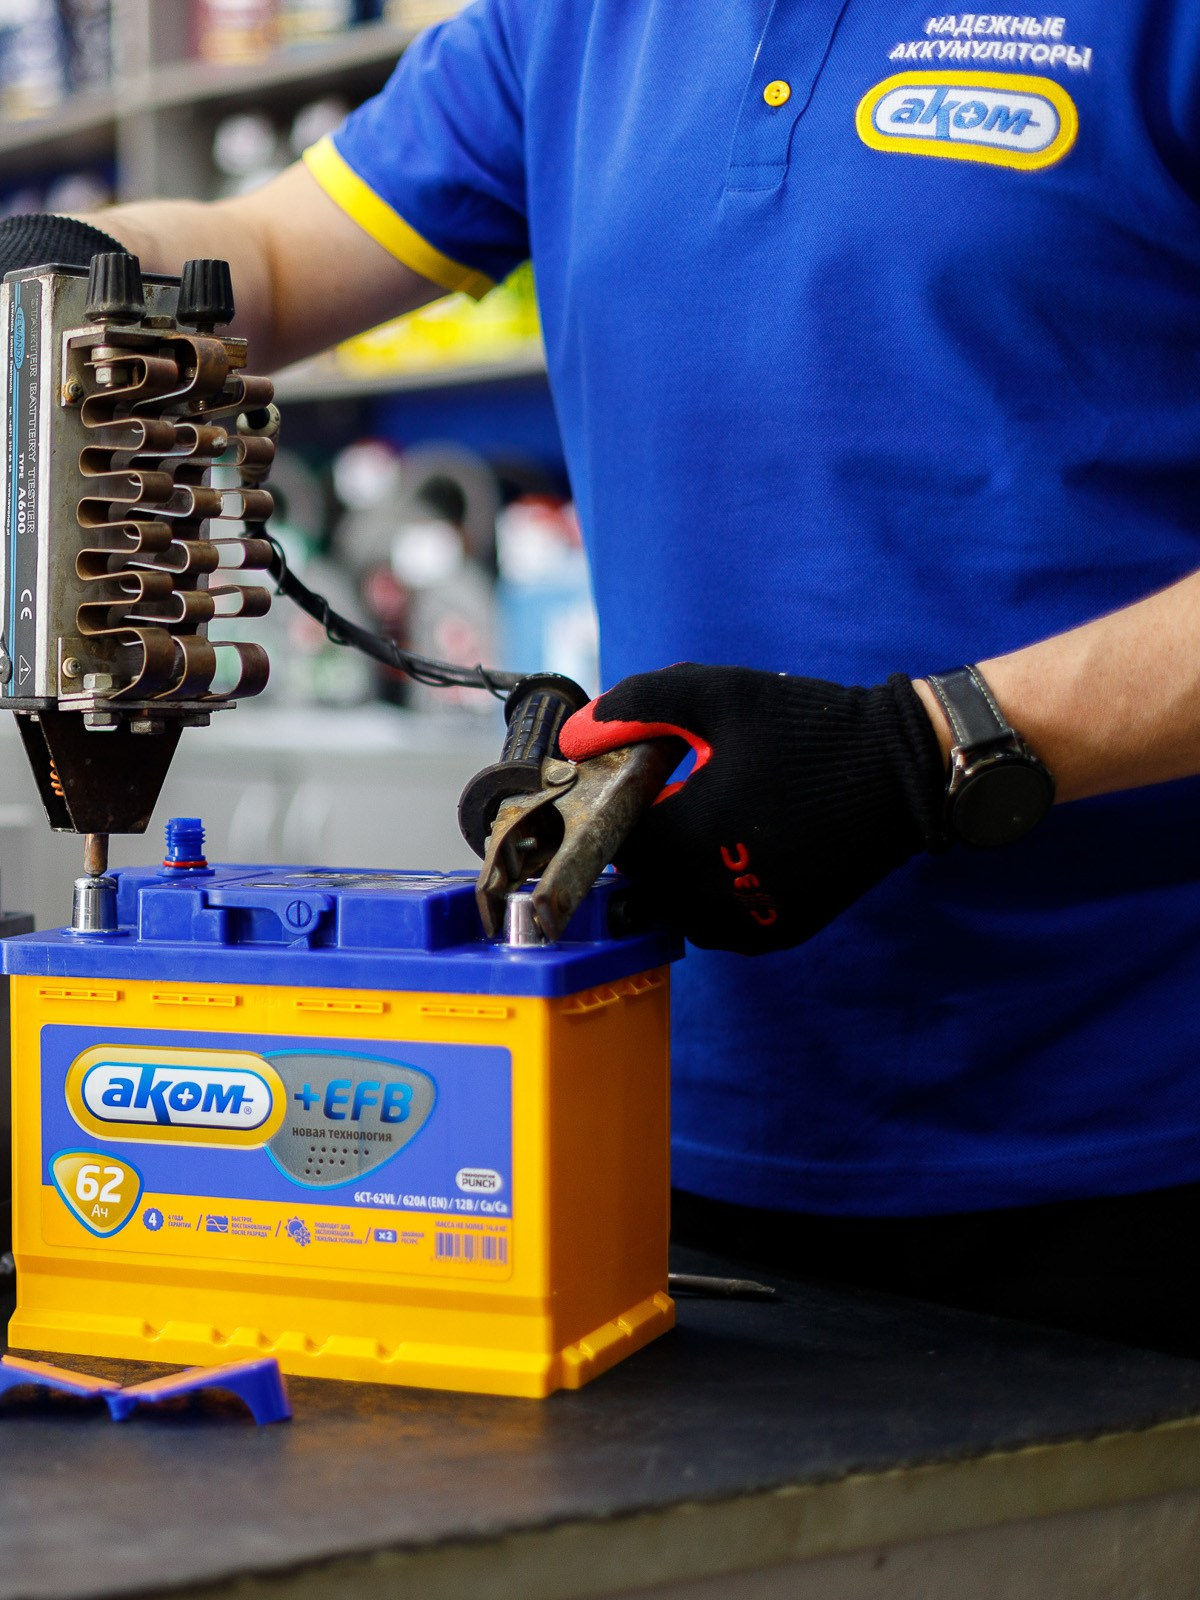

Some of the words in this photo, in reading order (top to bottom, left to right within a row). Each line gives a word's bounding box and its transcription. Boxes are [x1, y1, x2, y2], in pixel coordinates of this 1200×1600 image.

[926, 13, 1067, 38] НАДЕЖНЫЕ
[889, 40, 1093, 71] АККУМУЛЯТОРЫ
[29, 297, 39, 377] STARTER
[28, 382, 38, 463] BATTERY
[17, 487, 27, 534] A600
[27, 467, 36, 534] TESTER
[293, 1079, 414, 1124] +EFB
[292, 1126, 325, 1140] новая
[327, 1127, 393, 1142] технология
[75, 1164, 125, 1204] 62
[462, 1178, 496, 1189] PUNCH
[91, 1204, 109, 1219] Ач
[427, 1196, 448, 1210] (EN)
[148, 1212, 157, 1227] 4
